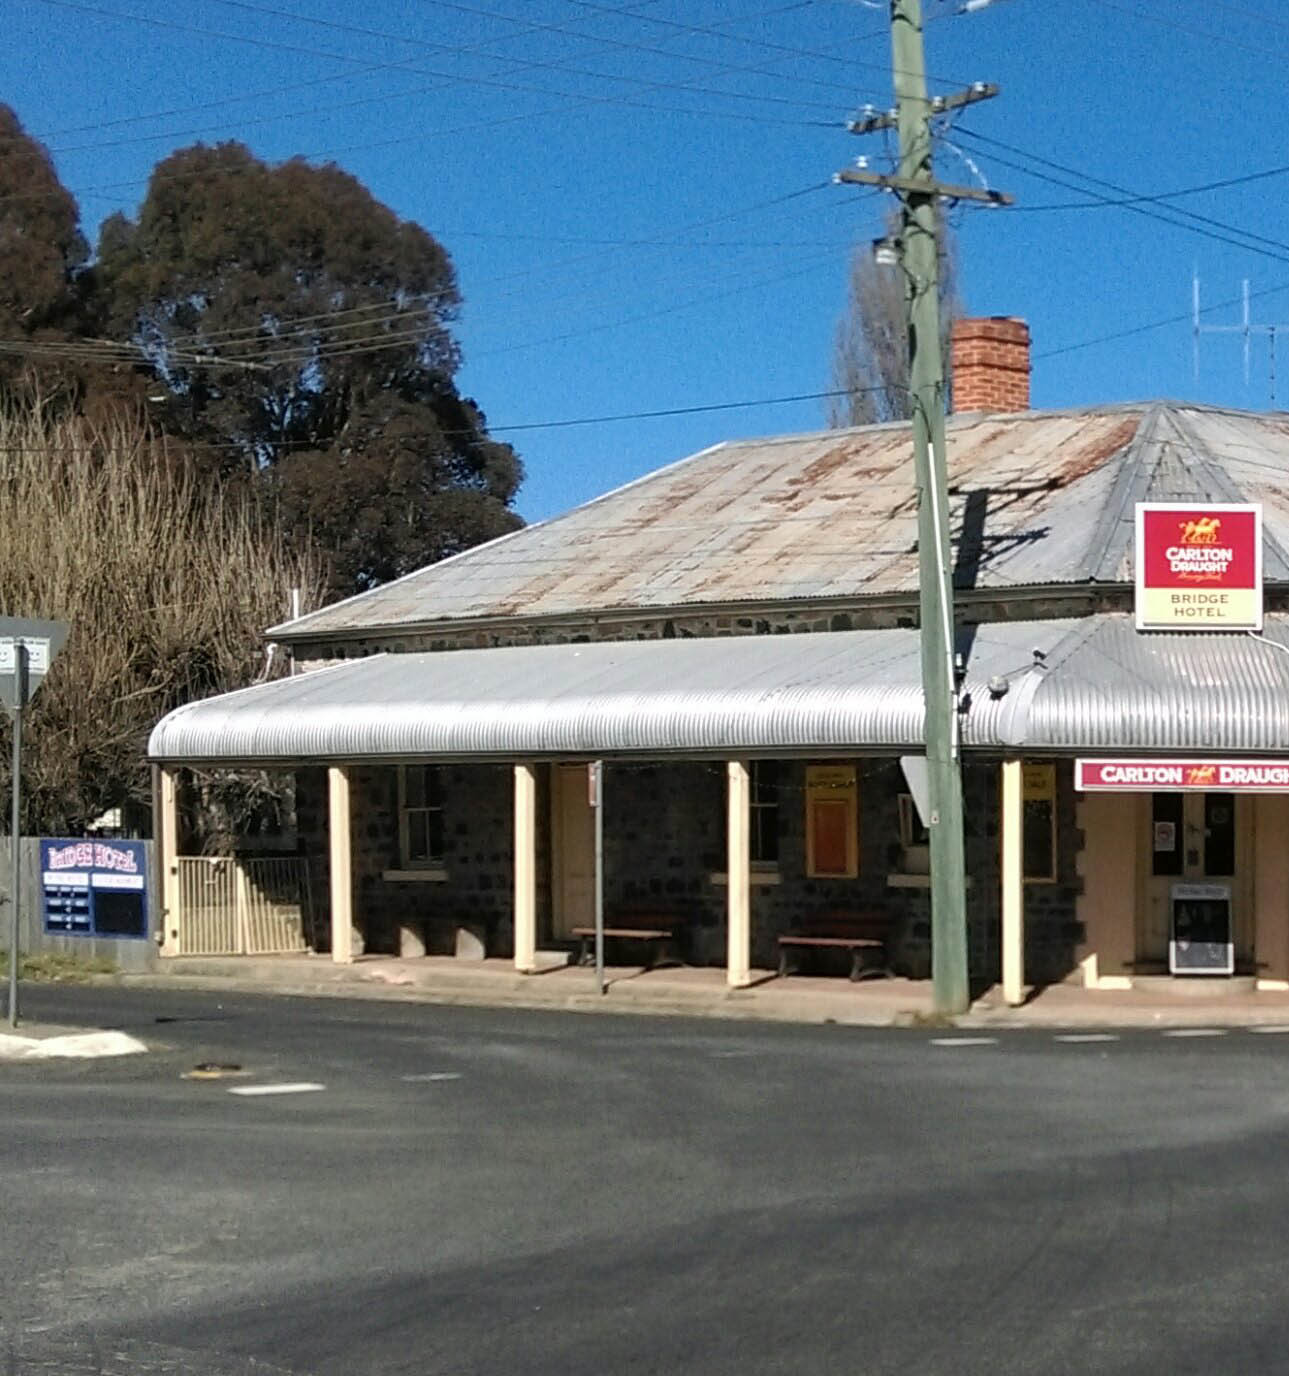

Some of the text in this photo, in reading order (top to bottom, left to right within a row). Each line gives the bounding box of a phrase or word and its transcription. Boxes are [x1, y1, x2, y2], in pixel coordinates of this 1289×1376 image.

[1166, 547, 1232, 560] CARLTON
[1171, 561, 1227, 572] DRAUGHT
[1171, 594, 1228, 603] BRIDGE
[1174, 607, 1225, 616] HOTEL
[1100, 766, 1182, 783] CARLTON
[94, 843, 137, 872] HOTEL
